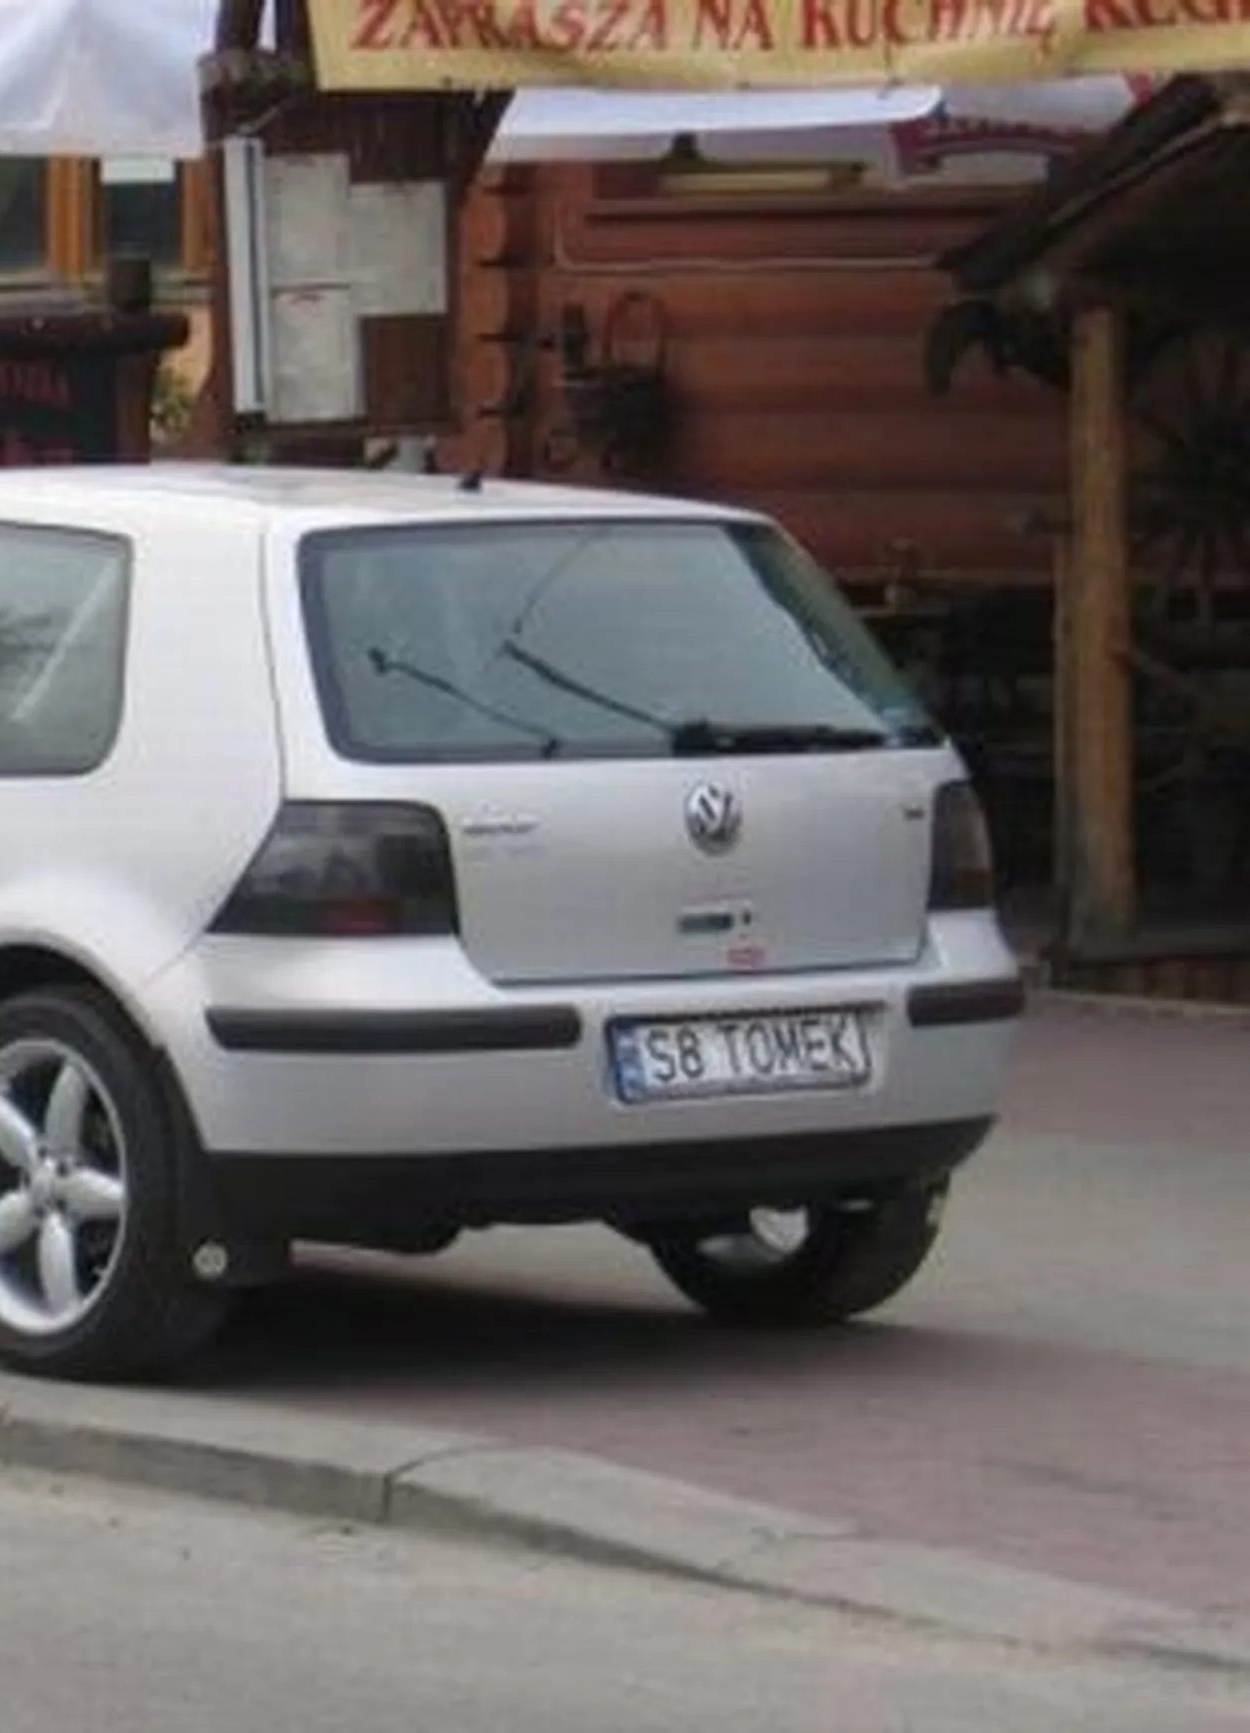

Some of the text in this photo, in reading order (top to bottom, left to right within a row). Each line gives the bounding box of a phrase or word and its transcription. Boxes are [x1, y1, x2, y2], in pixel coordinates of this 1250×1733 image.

[350, 0, 668, 52] ZAPRASZA
[692, 0, 775, 51] NA
[716, 1012, 856, 1074] TOMEK
